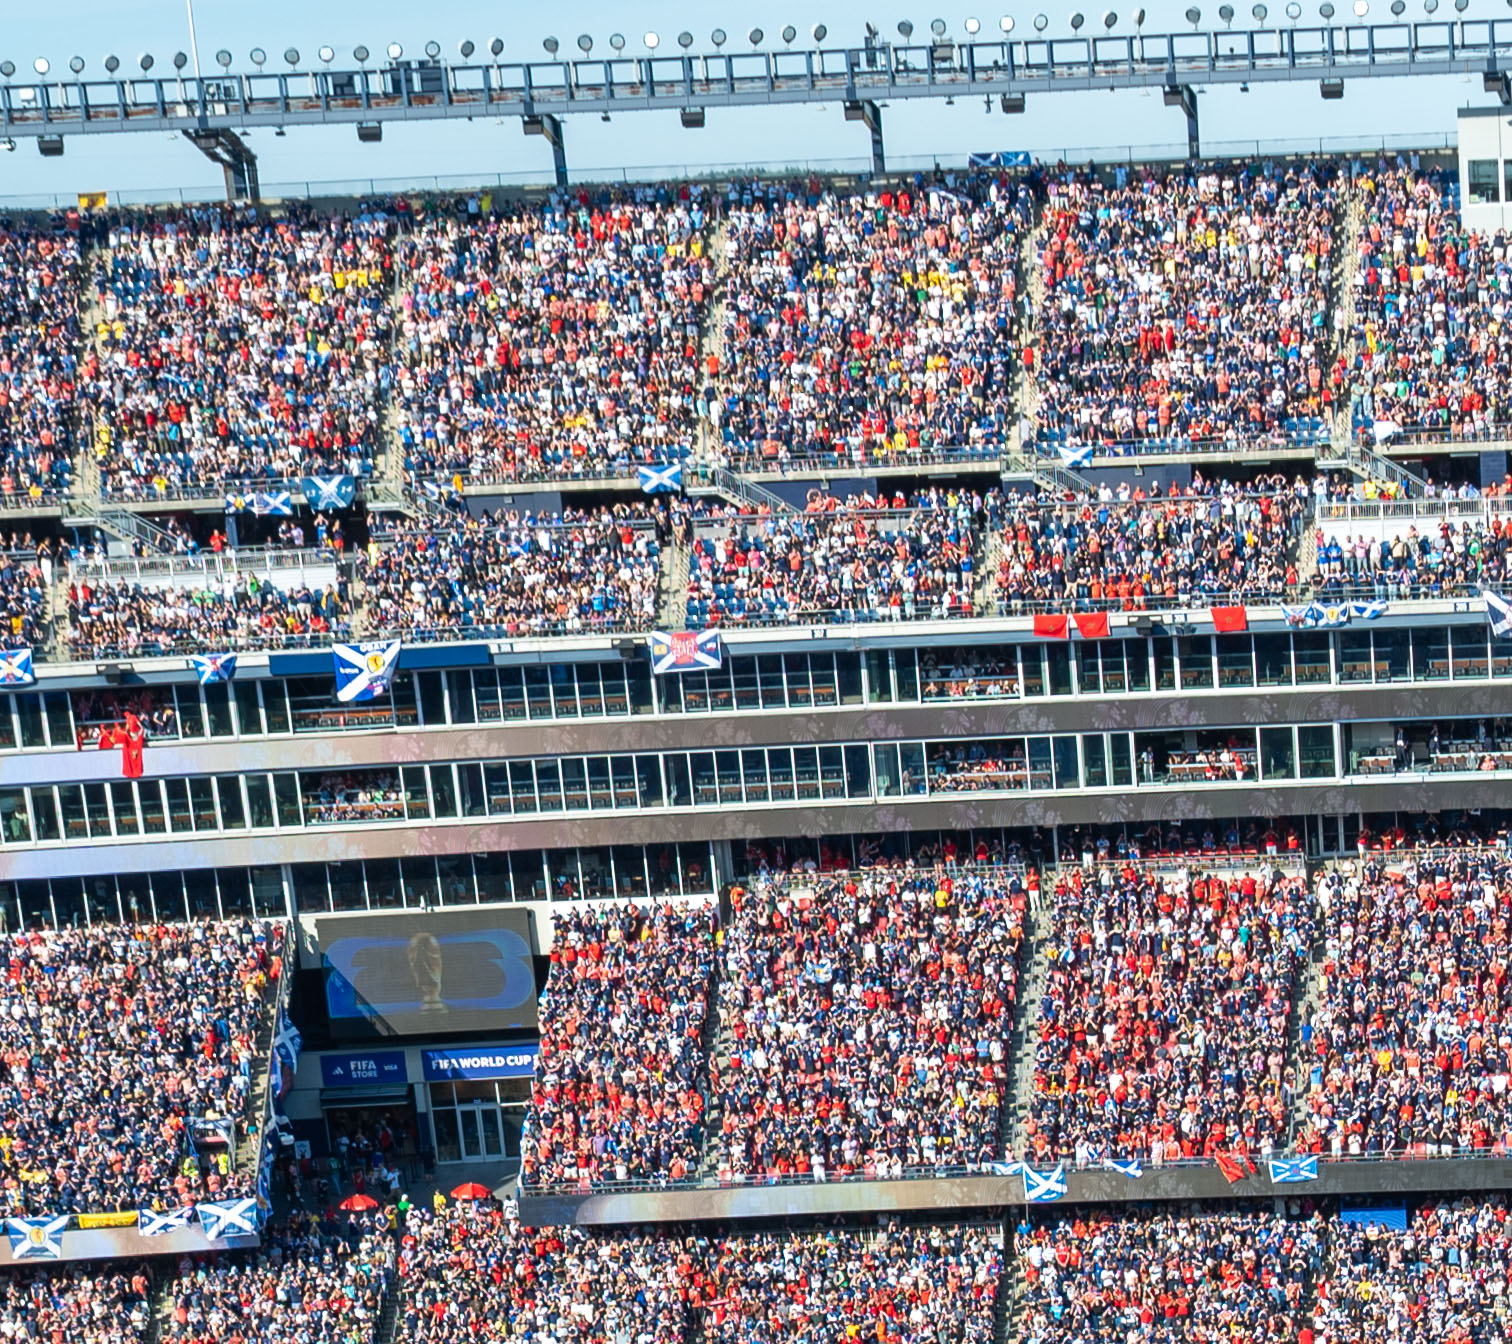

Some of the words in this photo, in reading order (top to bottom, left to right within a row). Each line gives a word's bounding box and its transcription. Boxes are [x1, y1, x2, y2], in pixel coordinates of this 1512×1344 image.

[350, 1060, 376, 1070] FIFA
[431, 1059, 458, 1070] FIFA
[459, 1056, 505, 1069] WORLD
[506, 1054, 532, 1067] CUP
